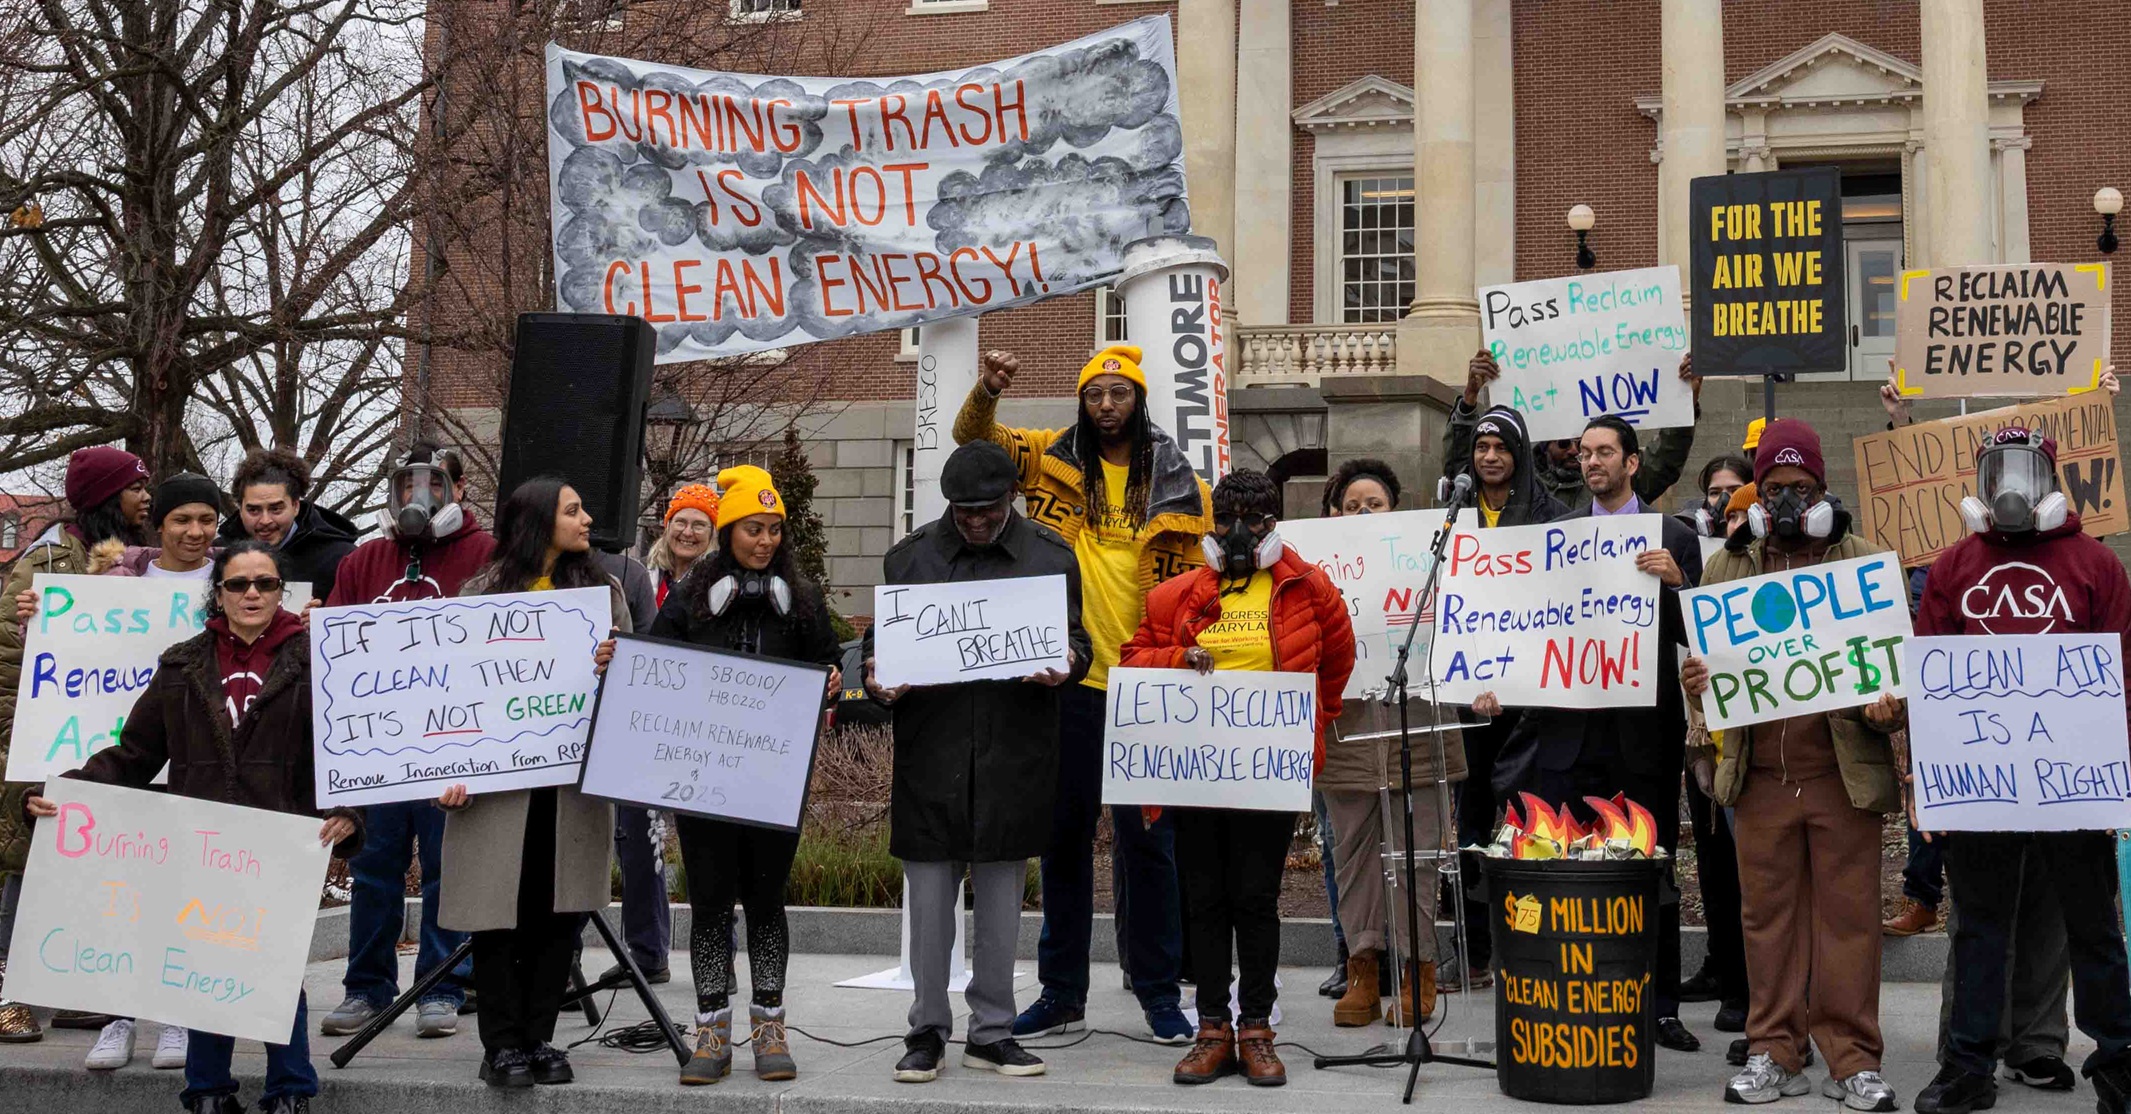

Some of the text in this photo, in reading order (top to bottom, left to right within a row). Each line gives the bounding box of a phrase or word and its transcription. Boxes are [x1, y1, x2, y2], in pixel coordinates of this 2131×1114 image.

[577, 79, 1030, 154] BURNING TRASH
[696, 162, 930, 230] IS NOT
[1711, 200, 1822, 242] FOR THE
[604, 241, 1050, 323] CLEAN ENERGY!
[1712, 251, 1822, 290] AIR WE
[1934, 269, 2069, 302] RECLAIM
[1486, 282, 1662, 329] Pass Reclaim
[1713, 299, 1823, 337] BREATHE
[1928, 302, 2085, 338] RENEWABLE
[1490, 323, 1687, 369] Renewable Energy
[1925, 339, 2077, 376] ENERGY
[1169, 274, 1214, 489] LTIMORE
[1207, 277, 1231, 477] INERATOR
[1513, 368, 1659, 416] Act NOW
[915, 354, 939, 451] BRESCO
[1775, 454, 1804, 464] CASA
[1862, 404, 2116, 491] END ENNMENTAL
[2063, 457, 2116, 516] W!
[1450, 527, 1647, 577] Pass Reclaim
[40, 586, 150, 634] Pass
[883, 588, 990, 637] I CAN'T
[1221, 610, 1268, 620] OGRESS
[1383, 587, 1440, 613] NO
[1442, 587, 1655, 635] Renewable Energy
[1961, 584, 2075, 622] CASA
[398, 615, 467, 651] IT'S
[488, 610, 546, 640] NOT
[957, 627, 1062, 669] BREATHE
[1386, 629, 1429, 660] Ene
[1748, 634, 1819, 664] OVER
[31, 652, 161, 699] Renewa
[351, 659, 555, 697] CLEAN, THEN
[627, 654, 689, 691] PASS
[1445, 631, 1640, 690] Act NOW!
[1921, 644, 2120, 692] CLEAN AIR
[708, 690, 766, 711] HB0220
[845, 689, 863, 700] K-9
[1114, 681, 1314, 733] LET'S RECLAIM
[337, 693, 586, 743] IT'S NOT GREEN
[629, 711, 792, 755] RECLAIM RENEWABLE
[1958, 710, 2054, 744] IS A
[328, 769, 389, 790] Remove
[512, 750, 547, 769] From
[654, 743, 744, 769] ENERGY ACT
[1111, 741, 1314, 789] RENEWABLE ENERGY
[661, 782, 727, 807] 2025
[1919, 758, 2131, 802] HUMAN RIGHT!
[56, 802, 260, 878] Burning Trash
[176, 898, 268, 939] NOT
[1551, 895, 1643, 935] MILLION
[40, 928, 254, 1003] Clean Energy
[1560, 943, 1593, 975] IN
[1511, 1018, 1638, 1069] SUBSIDIES
